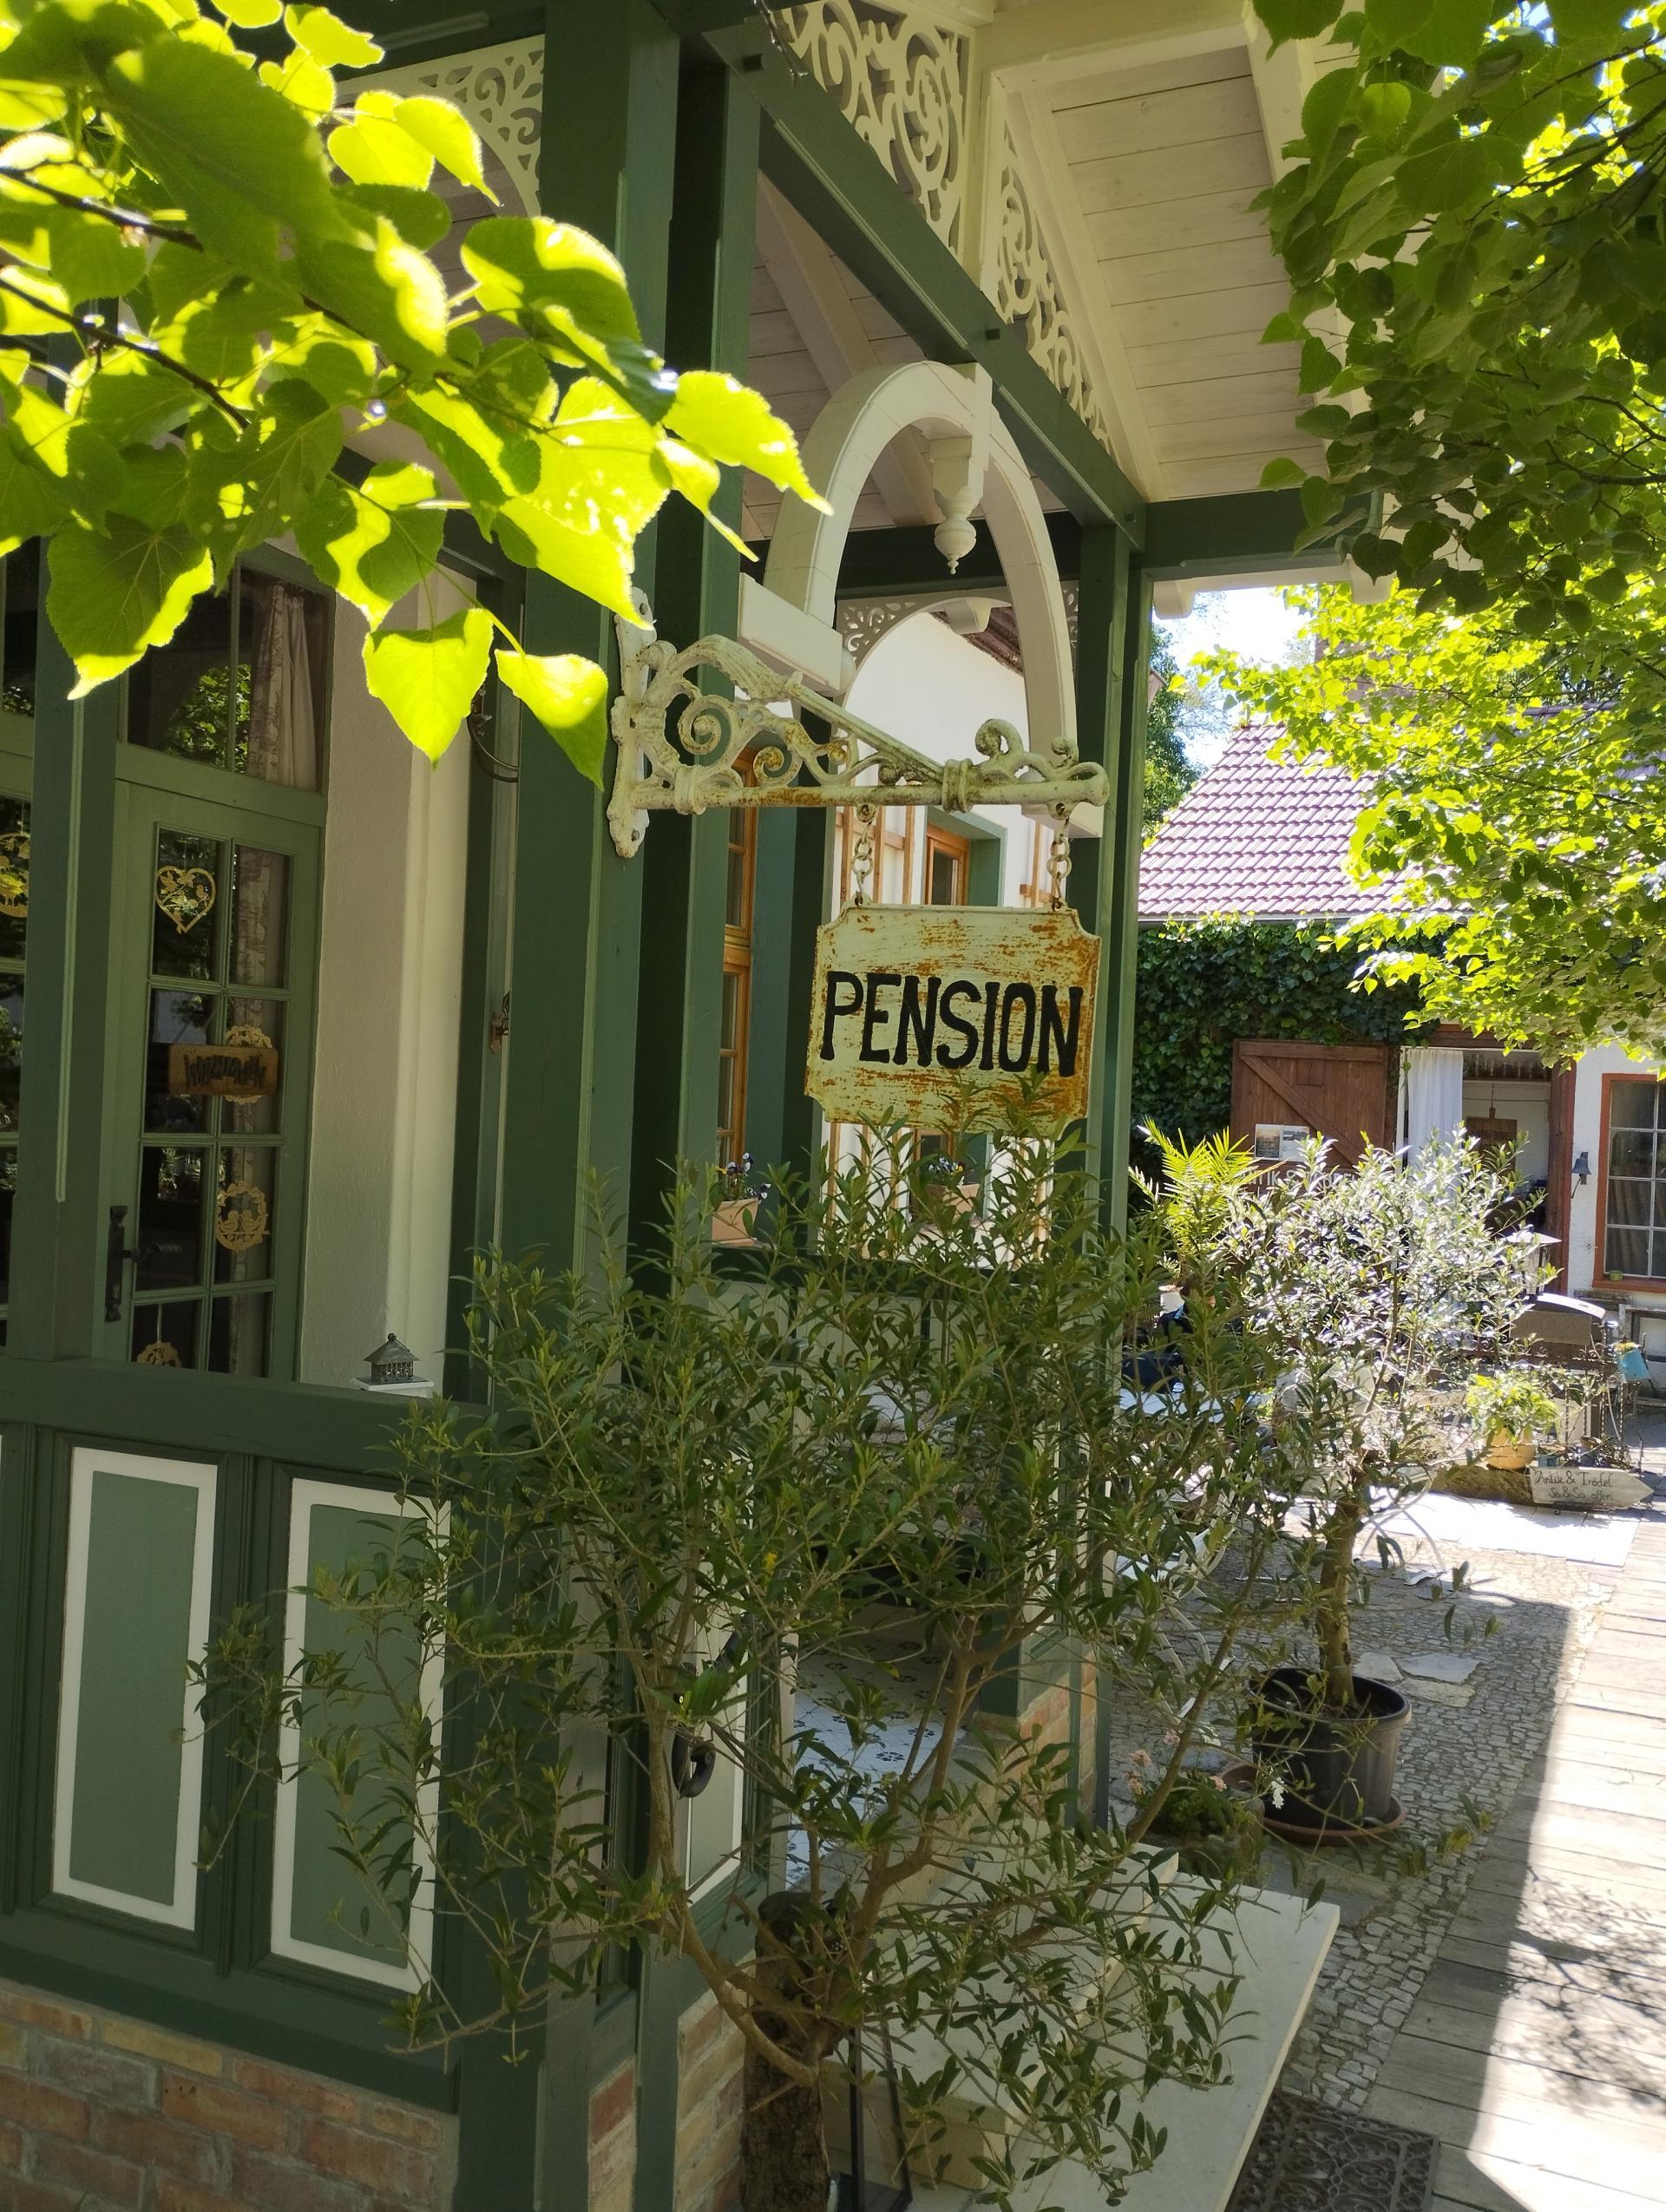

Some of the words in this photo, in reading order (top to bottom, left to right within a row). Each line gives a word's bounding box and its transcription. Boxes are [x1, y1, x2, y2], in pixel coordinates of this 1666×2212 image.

[819, 970, 1084, 1077] PENSION
[1535, 1470, 1564, 1483] Antik
[1565, 1470, 1576, 1483] &
[1576, 1471, 1612, 1487] Trödel
